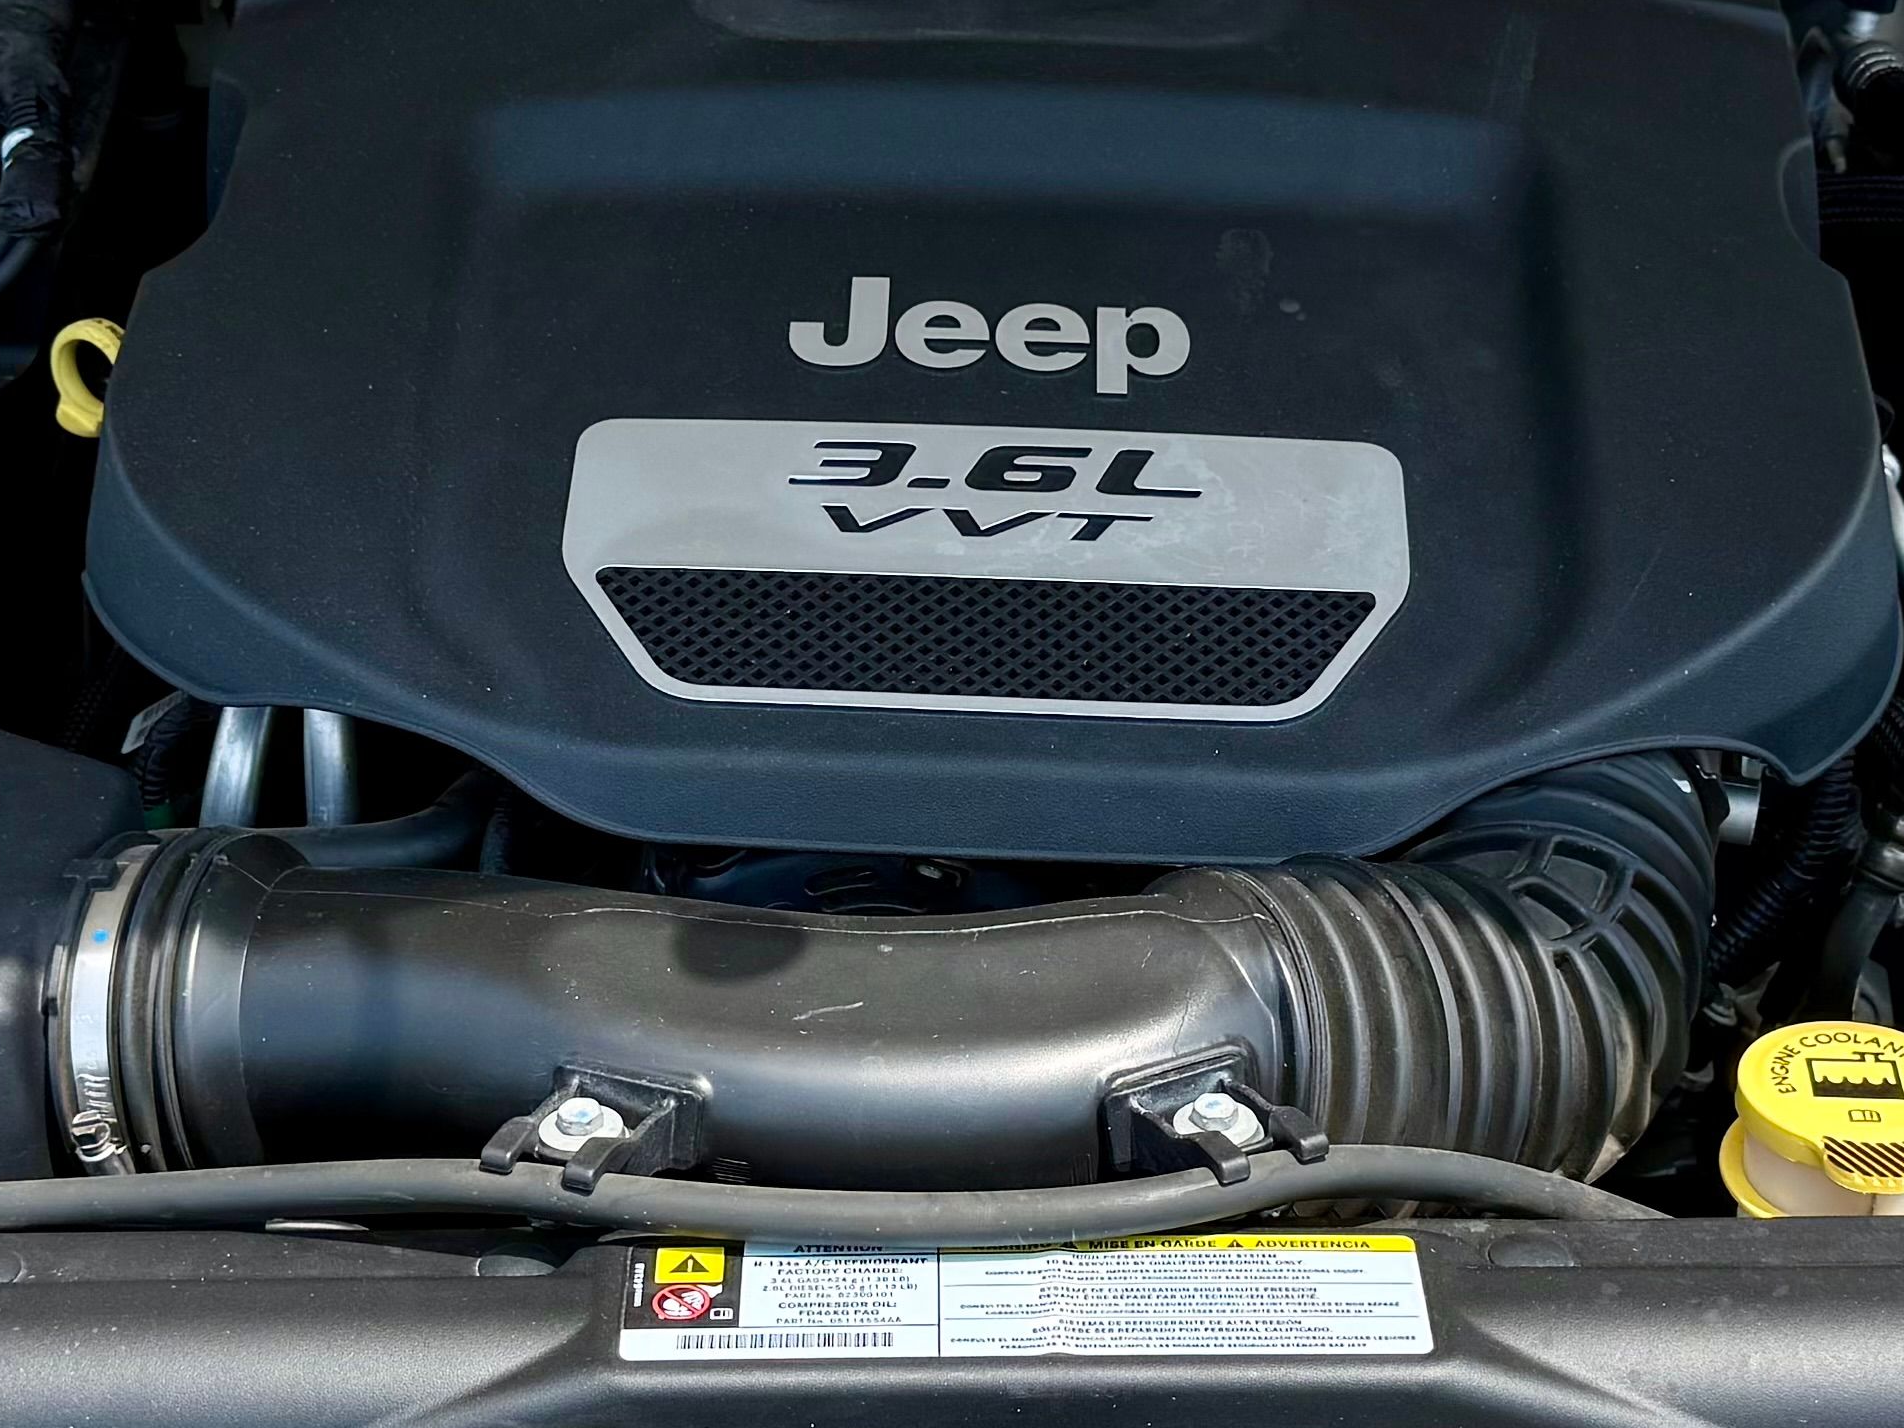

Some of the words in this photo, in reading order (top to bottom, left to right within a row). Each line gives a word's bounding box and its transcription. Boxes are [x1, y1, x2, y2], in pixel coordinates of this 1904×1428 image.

[787, 275, 1192, 395] Jeep
[787, 440, 1204, 500] 3.6L
[820, 502, 1156, 542] VVT
[1770, 1044, 1801, 1095] ENGINE
[1088, 1239, 1129, 1250] MISE
[1134, 1239, 1155, 1249] EN
[1255, 1240, 1370, 1249] ADVERTENCIA
[804, 1259, 831, 1267] A/C
[777, 1268, 840, 1276] FACTORY
[778, 1301, 869, 1309] COMPRESSOR
